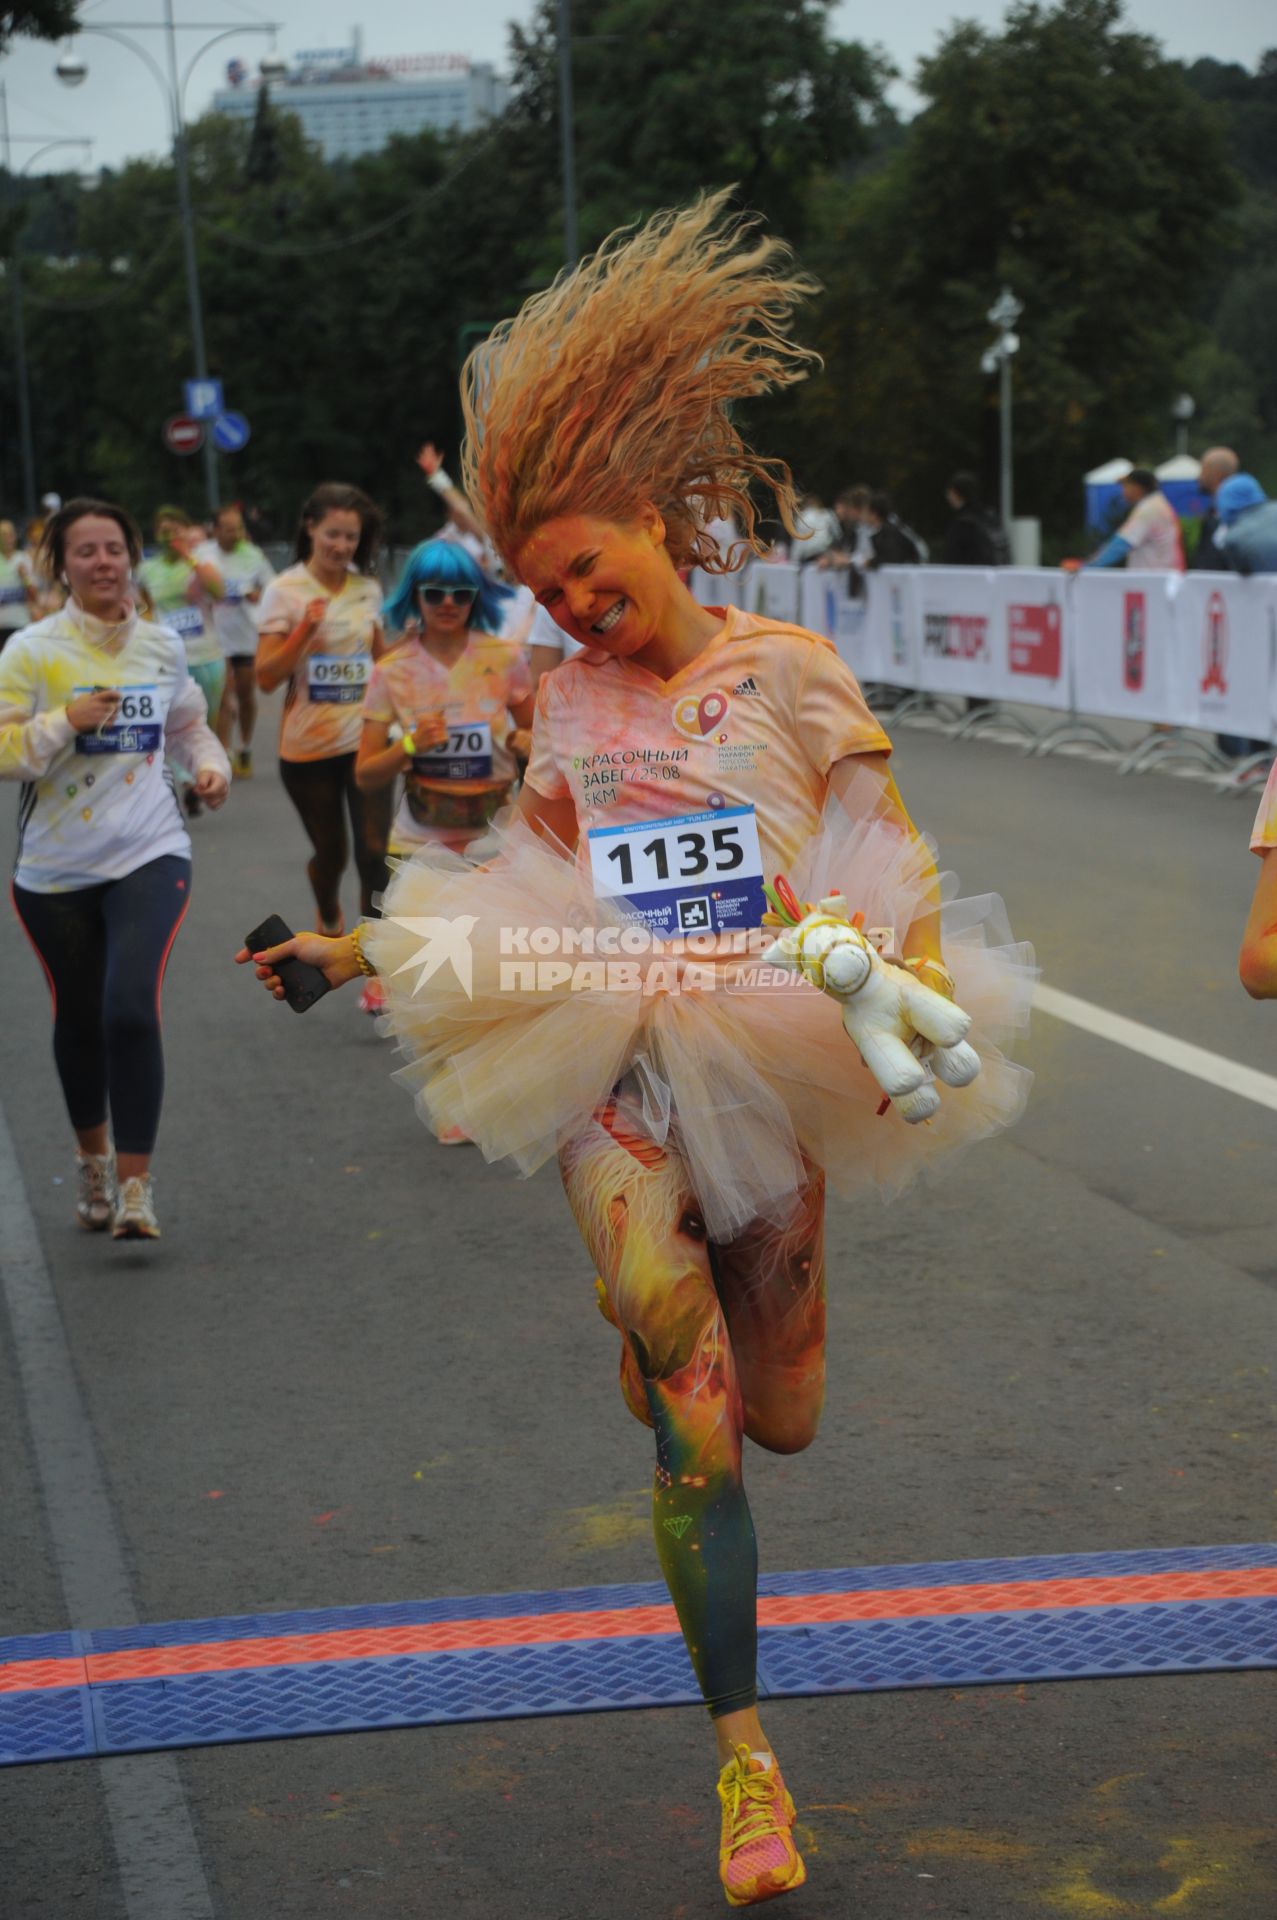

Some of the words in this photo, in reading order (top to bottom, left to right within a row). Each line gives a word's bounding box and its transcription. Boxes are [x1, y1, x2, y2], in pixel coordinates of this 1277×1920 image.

[314, 661, 367, 682] 0963
[120, 695, 154, 719] 68
[582, 747, 689, 770] КРАСОЧНЫЙ
[582, 767, 630, 789] ЗАБЕГ
[607, 826, 744, 885] 1135
